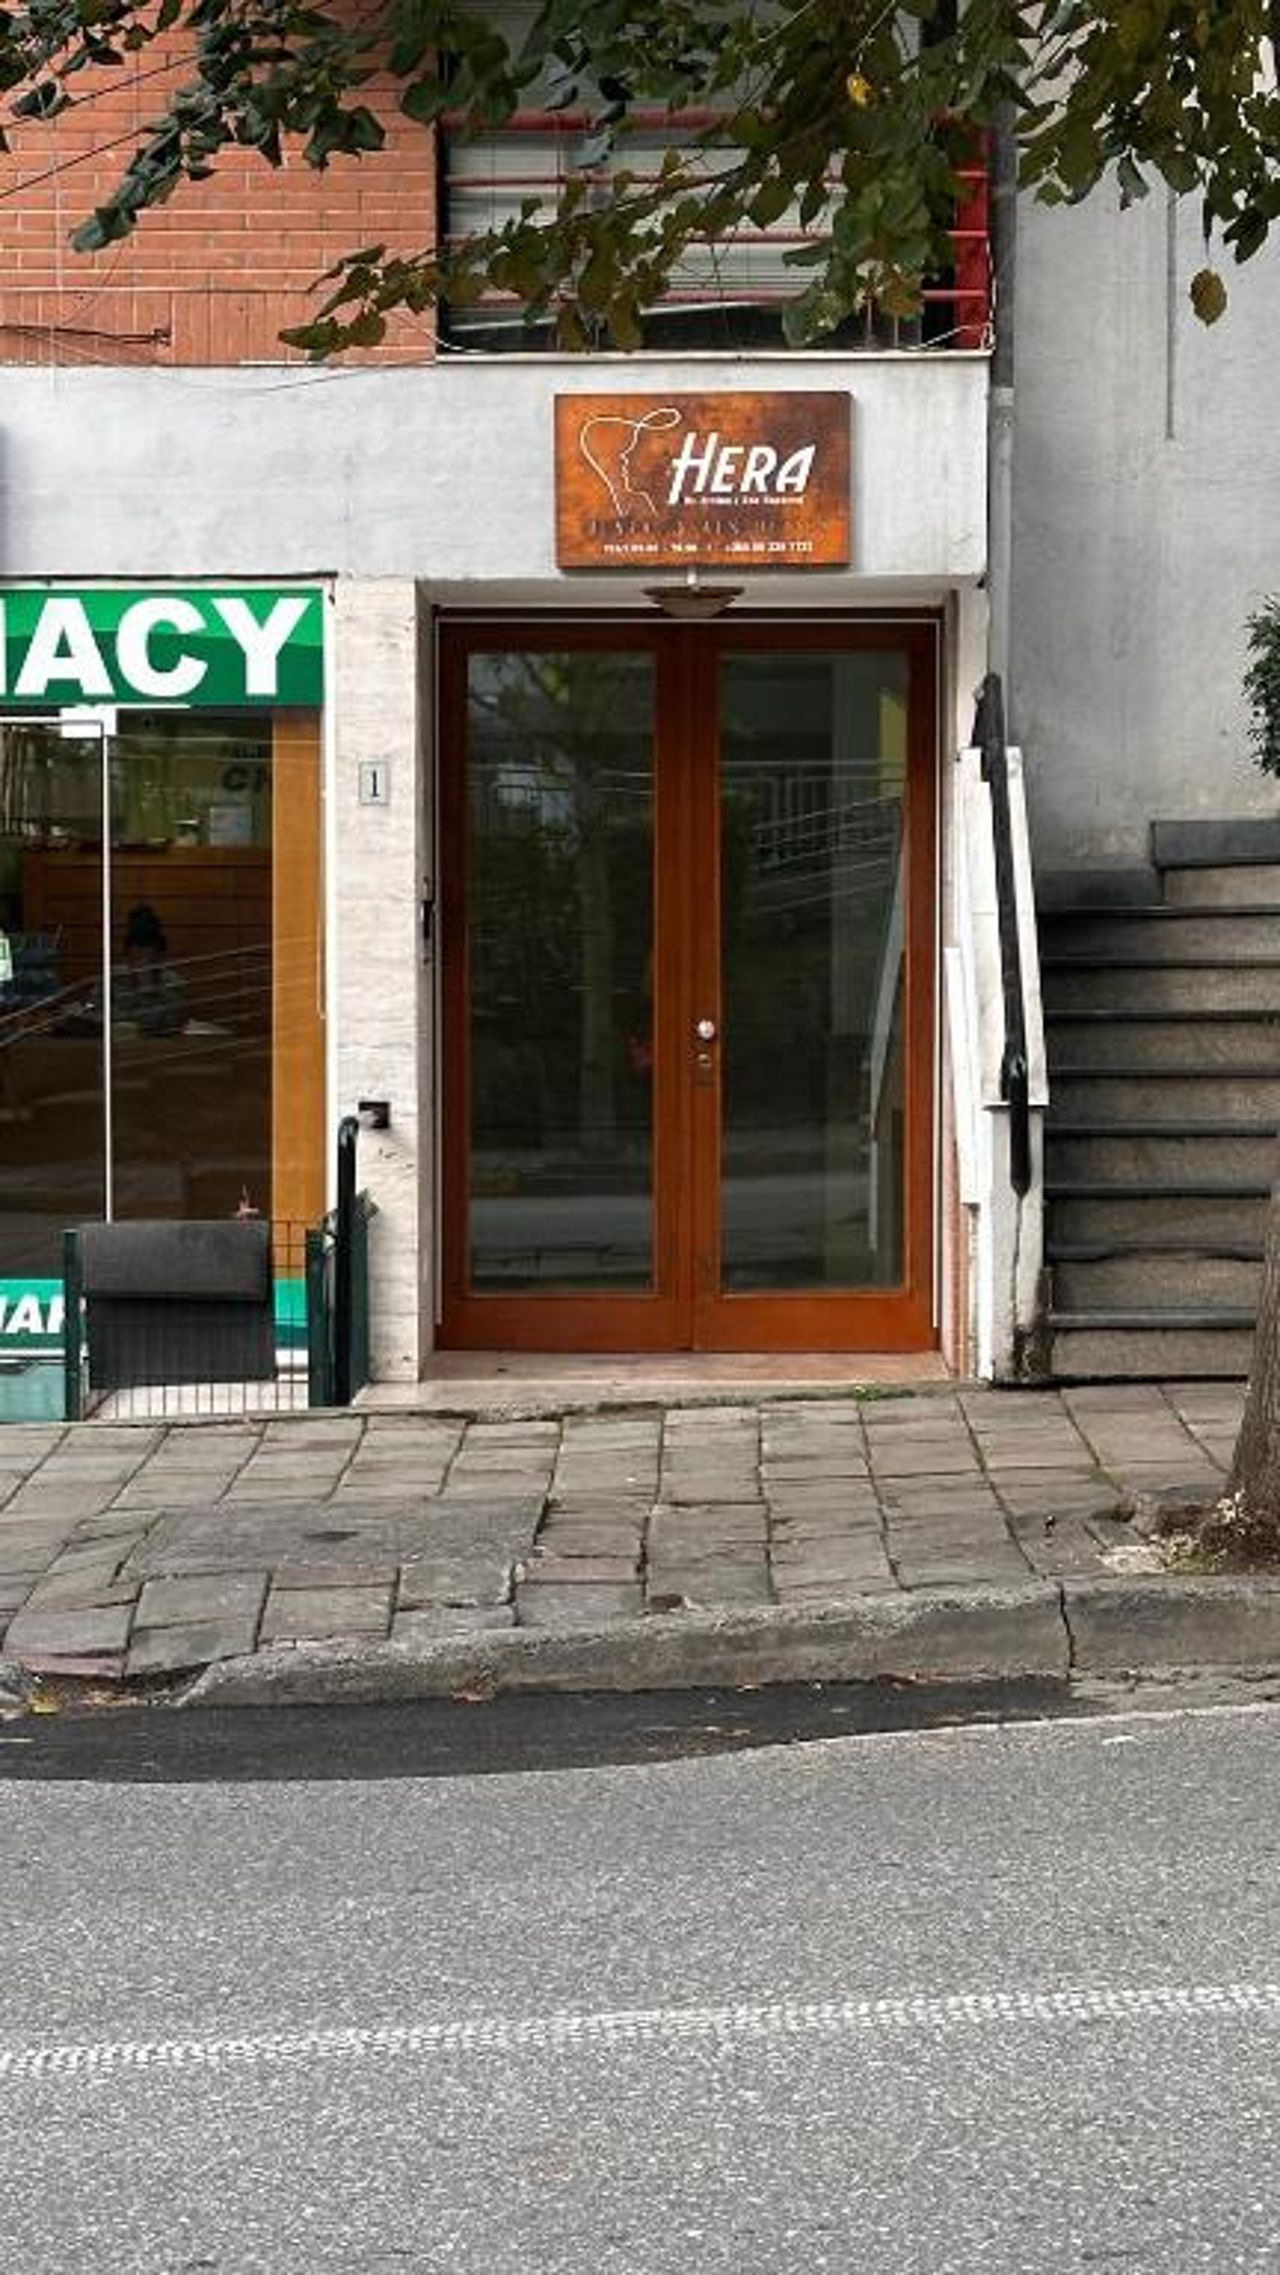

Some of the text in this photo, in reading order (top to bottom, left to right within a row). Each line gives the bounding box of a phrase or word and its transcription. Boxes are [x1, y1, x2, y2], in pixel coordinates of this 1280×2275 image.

[668, 432, 816, 505] HERA
[0, 597, 312, 697] ACY
[370, 770, 380, 797] 1
